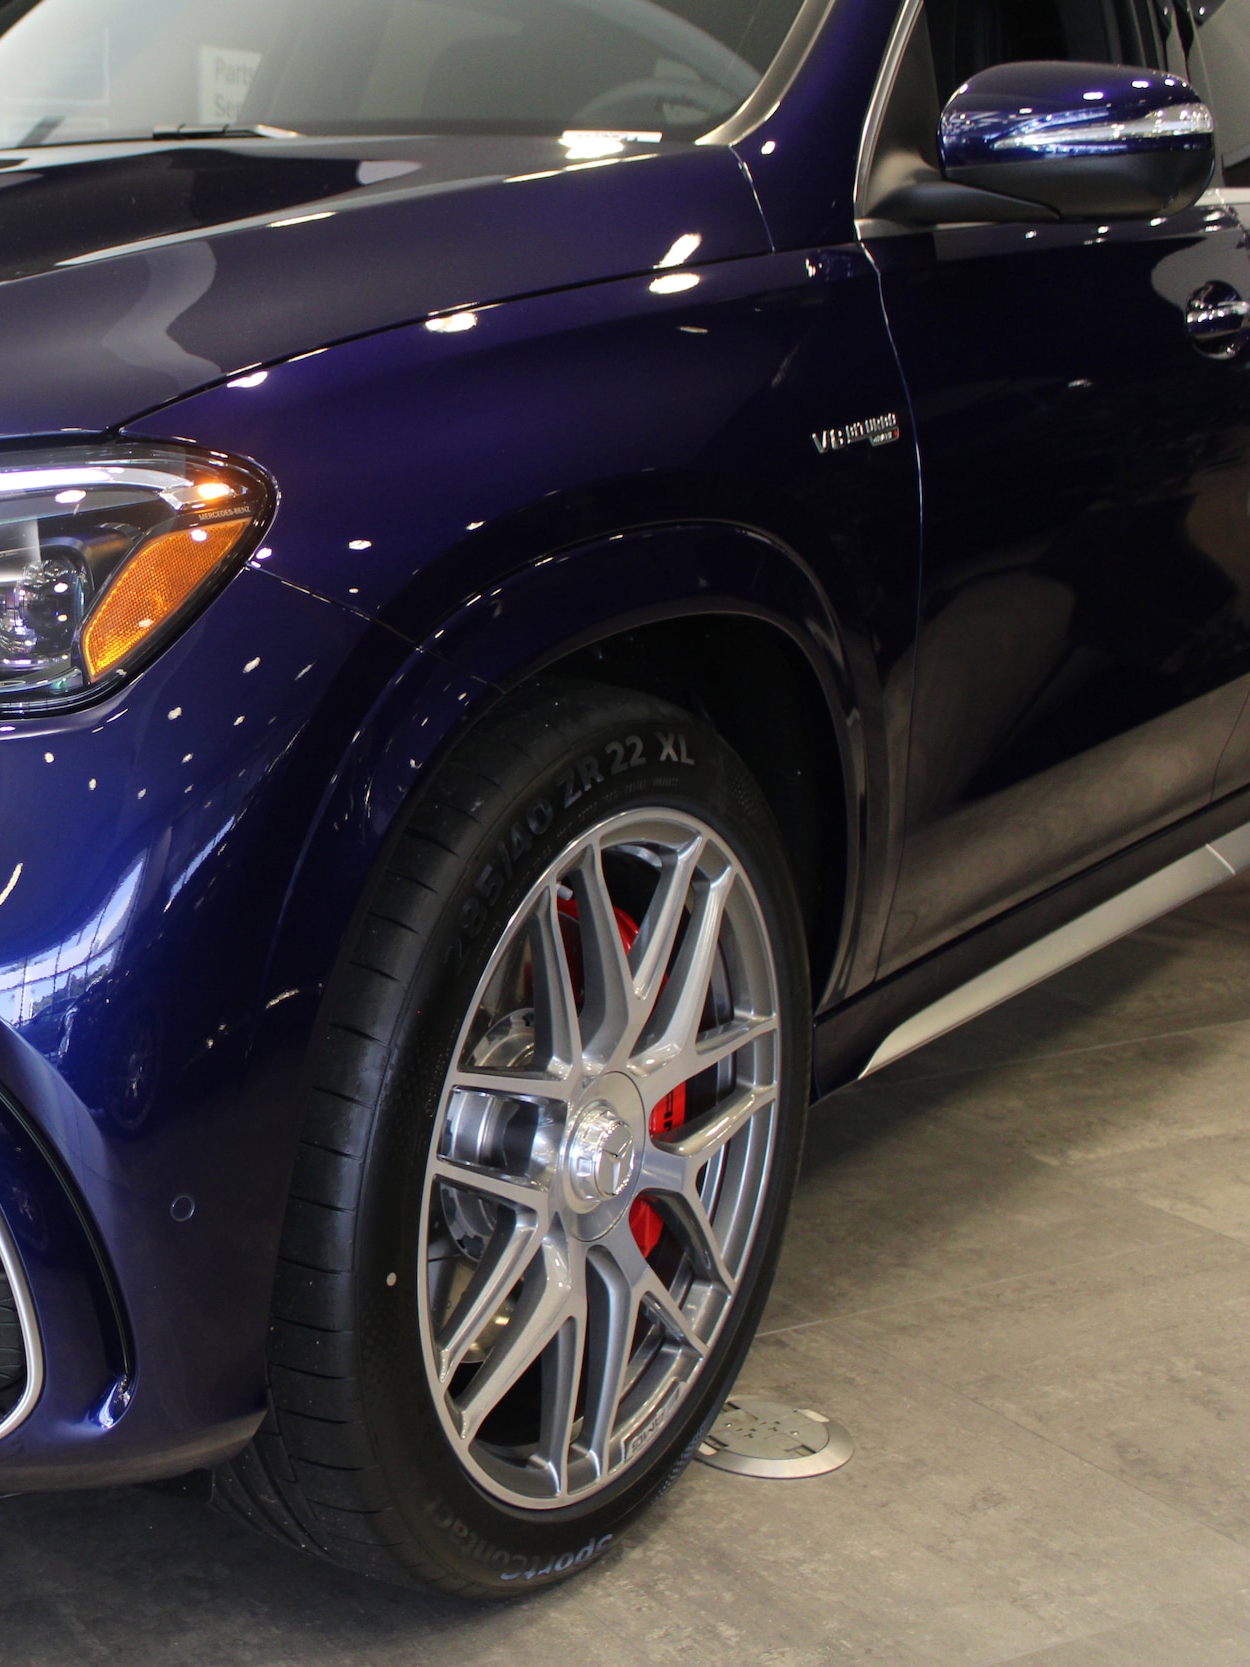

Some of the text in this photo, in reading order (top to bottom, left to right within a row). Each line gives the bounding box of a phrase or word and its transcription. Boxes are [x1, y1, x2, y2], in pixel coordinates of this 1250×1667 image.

[198, 506, 251, 520] MERCEDES-BENZ
[556, 754, 605, 809] ZR
[604, 735, 647, 776] 22
[655, 731, 696, 767] XL
